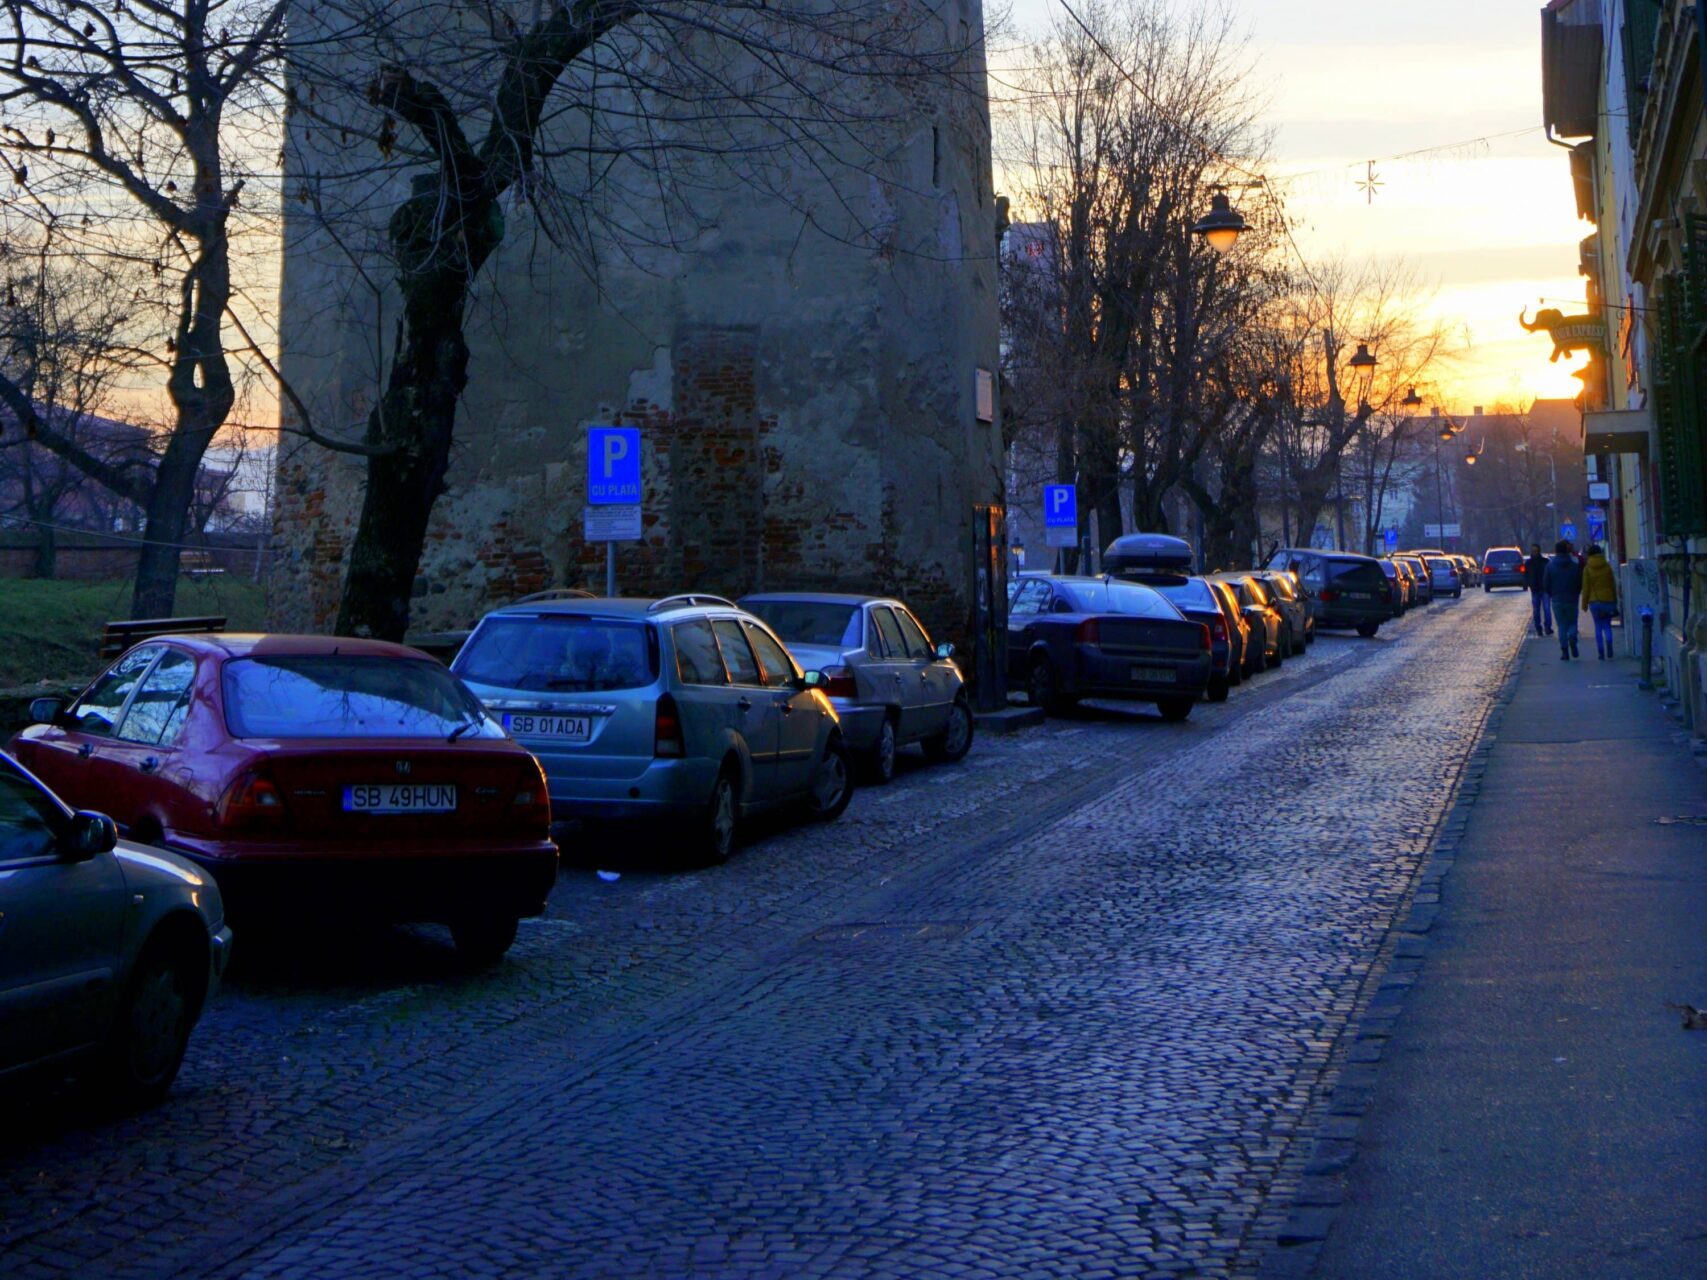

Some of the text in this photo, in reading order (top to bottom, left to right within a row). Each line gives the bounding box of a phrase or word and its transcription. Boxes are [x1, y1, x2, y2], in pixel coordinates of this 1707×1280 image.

[604, 434, 628, 478] P
[592, 484, 605, 497] CU
[1053, 488, 1069, 513] P
[513, 716, 583, 736] SB 01 ADA
[353, 786, 381, 807] SB
